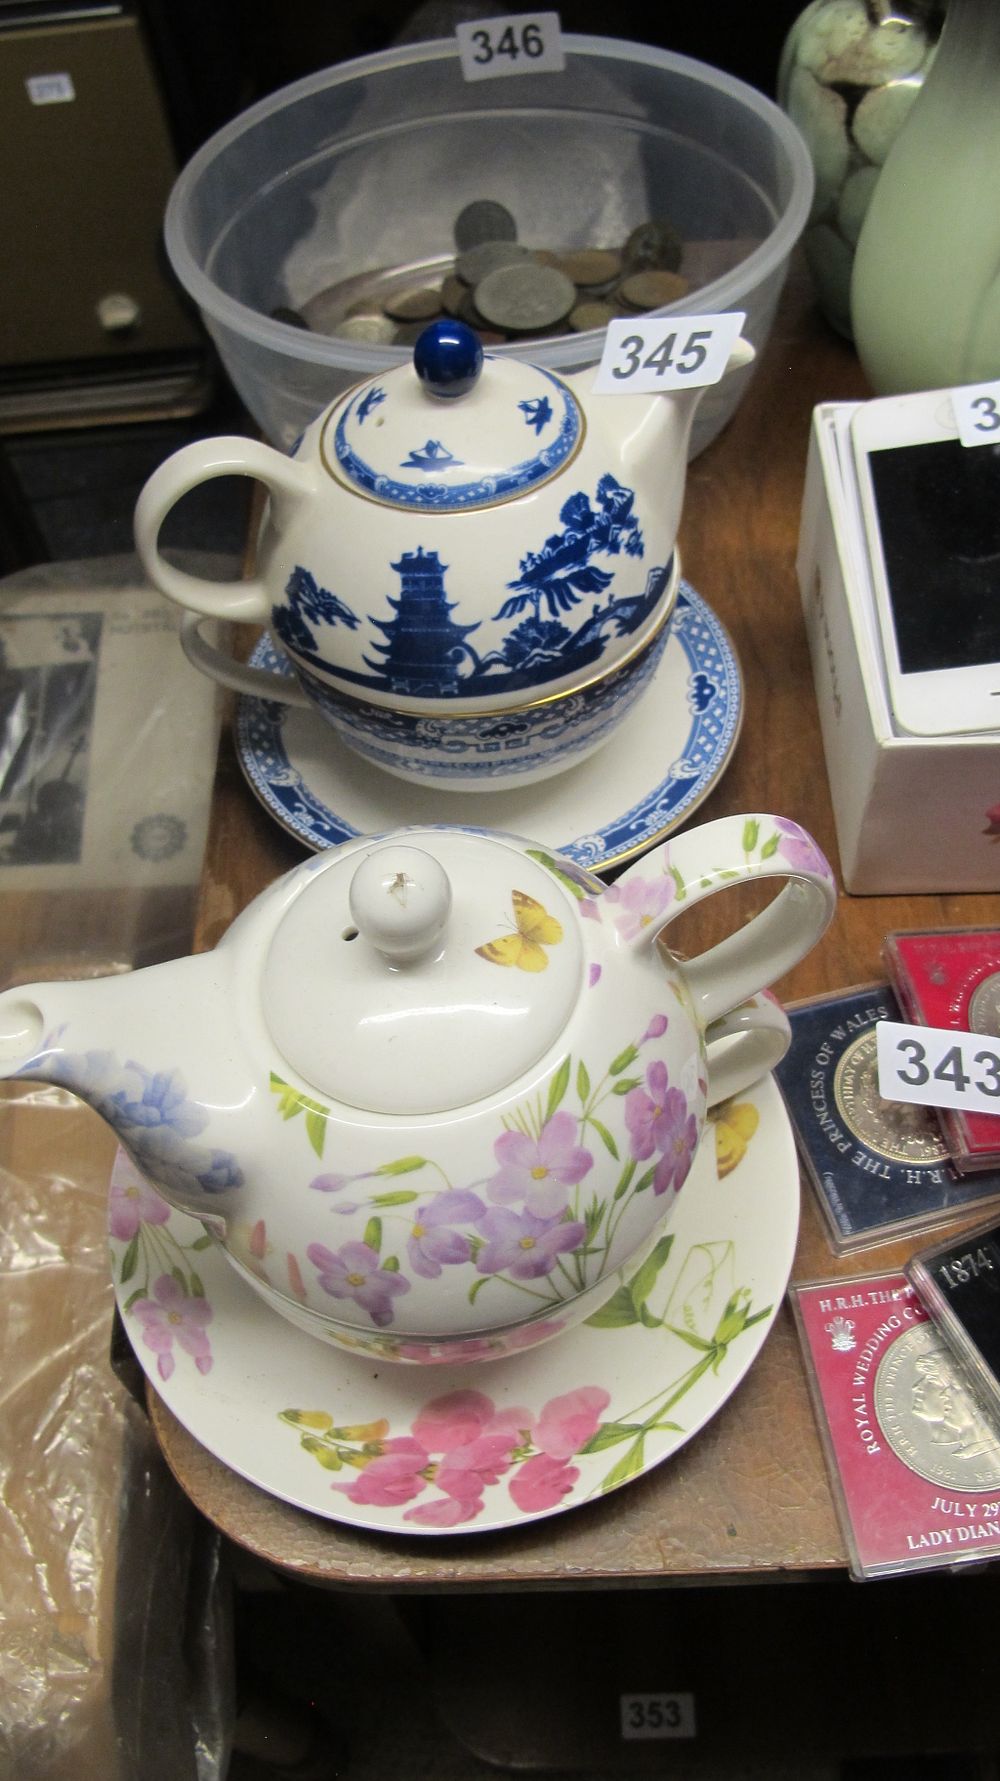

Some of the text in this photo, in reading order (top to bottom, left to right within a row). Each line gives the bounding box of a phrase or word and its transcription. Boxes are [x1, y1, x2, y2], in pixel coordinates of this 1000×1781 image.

[472, 23, 544, 65] 346
[611, 330, 713, 380] 345
[829, 1006, 889, 1040] WALES
[815, 1042, 834, 1066] OF
[896, 1038, 1000, 1098] 343
[810, 1069, 853, 1154] PRINCESS
[851, 1151, 891, 1180] THE
[939, 1248, 994, 1290] 1874
[852, 1315, 902, 1386] WEDDING
[852, 1392, 881, 1455] ROYAL
[930, 1497, 1000, 1517] JULY 29
[906, 1528, 953, 1550] LADY
[628, 1701, 682, 1728] 353
